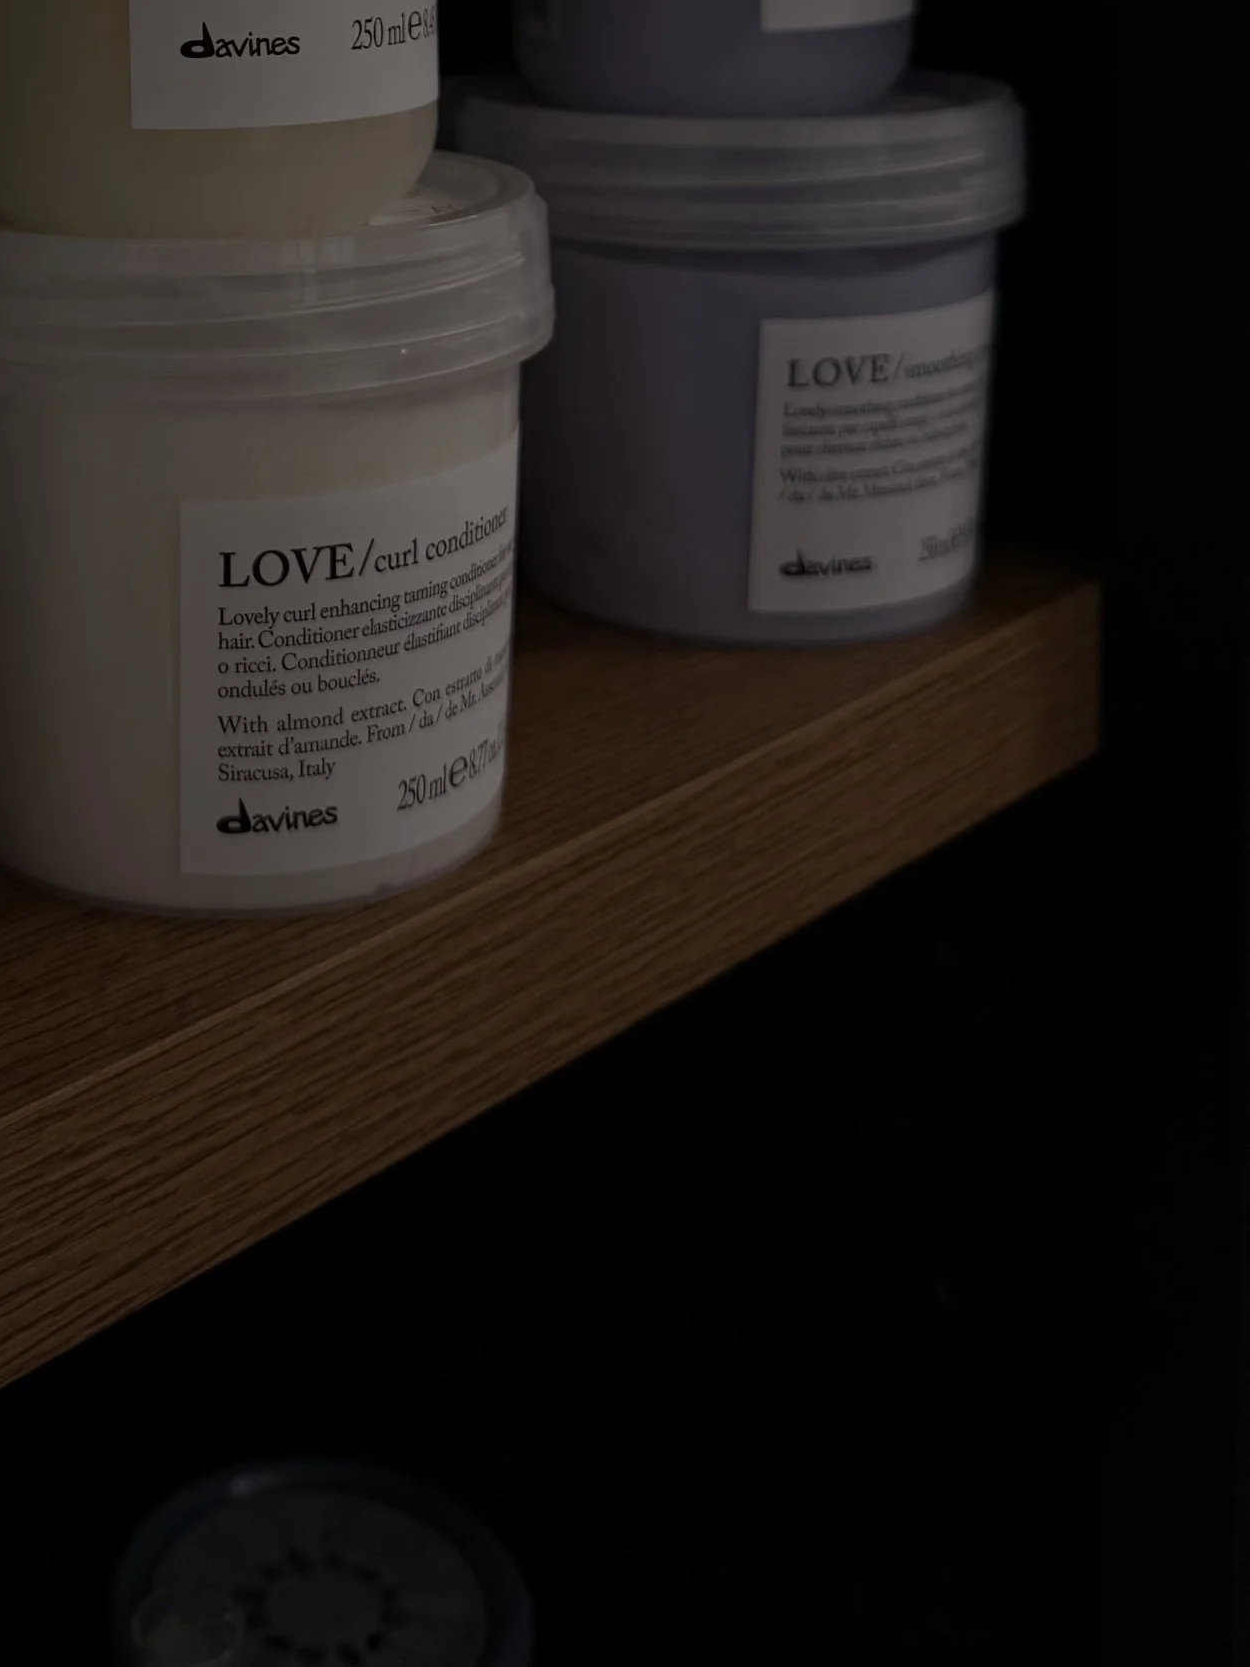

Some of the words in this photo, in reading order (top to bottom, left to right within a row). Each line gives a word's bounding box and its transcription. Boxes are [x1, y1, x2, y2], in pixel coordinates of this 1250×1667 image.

[179, 21, 301, 60] davines
[351, 16, 384, 51] 250
[387, 11, 407, 47] ml
[425, 505, 508, 561] conditioner
[779, 547, 875, 578] davines
[218, 606, 279, 630] Lovely
[283, 601, 316, 623] curl
[320, 591, 400, 619] enhancing
[404, 579, 448, 605] taming
[218, 632, 255, 651] hair.
[259, 623, 359, 650] Conditioner
[362, 603, 447, 638] elasticizzante
[235, 655, 276, 674] ricci.
[281, 641, 400, 672] Conditionneur
[217, 678, 286, 700] ondulés
[291, 680, 312, 695] ou
[317, 669, 380, 693] bouclés.
[217, 713, 268, 736] With
[276, 706, 343, 733] almond
[350, 699, 407, 724] extract.
[412, 687, 441, 708] Con
[217, 737, 274, 759] extrait
[278, 731, 362, 758] d'amande.
[366, 722, 406, 744] From
[218, 760, 294, 784] Siracusa,
[297, 757, 337, 781] Italy
[216, 796, 338, 835] davines
[397, 772, 427, 812] 250
[428, 761, 448, 800] ml
